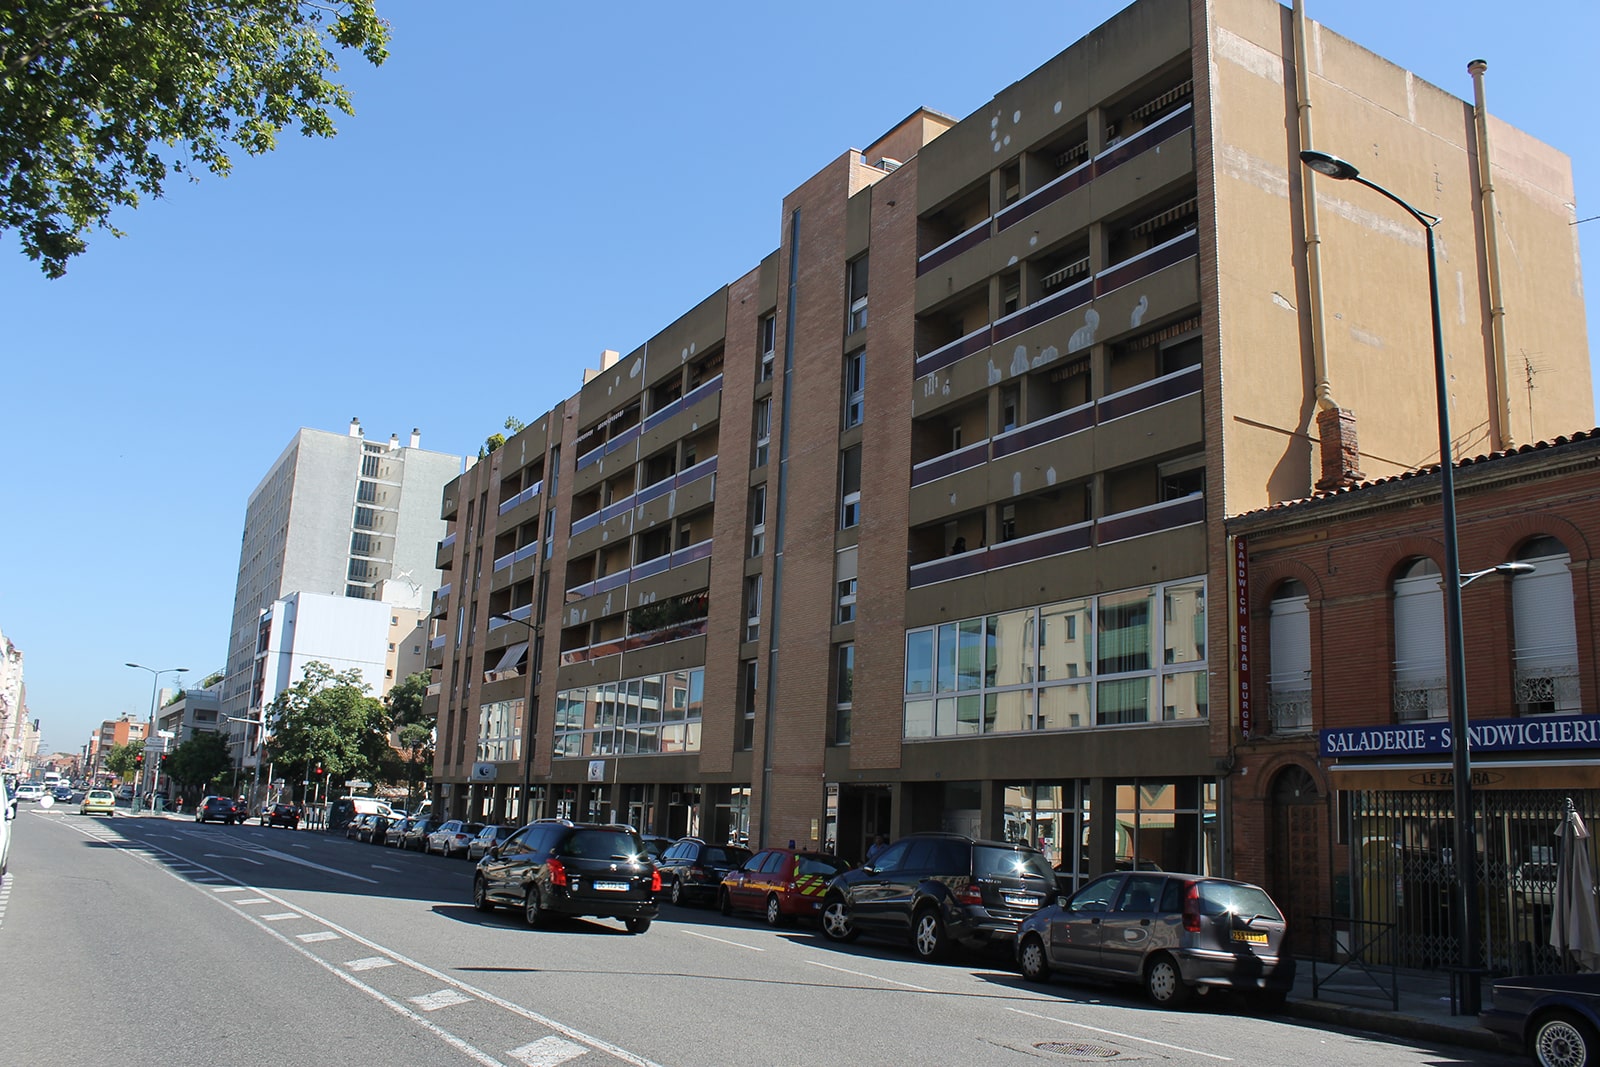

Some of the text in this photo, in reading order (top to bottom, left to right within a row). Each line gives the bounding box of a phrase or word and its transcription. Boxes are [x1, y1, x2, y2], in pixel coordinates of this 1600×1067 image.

[1238, 542, 1250, 738] SANDWICH KEBAB BURGER
[1327, 730, 1426, 753] SALADERIE
[1441, 720, 1600, 748] SNDWICHERI
[1422, 773, 1437, 784] LE
